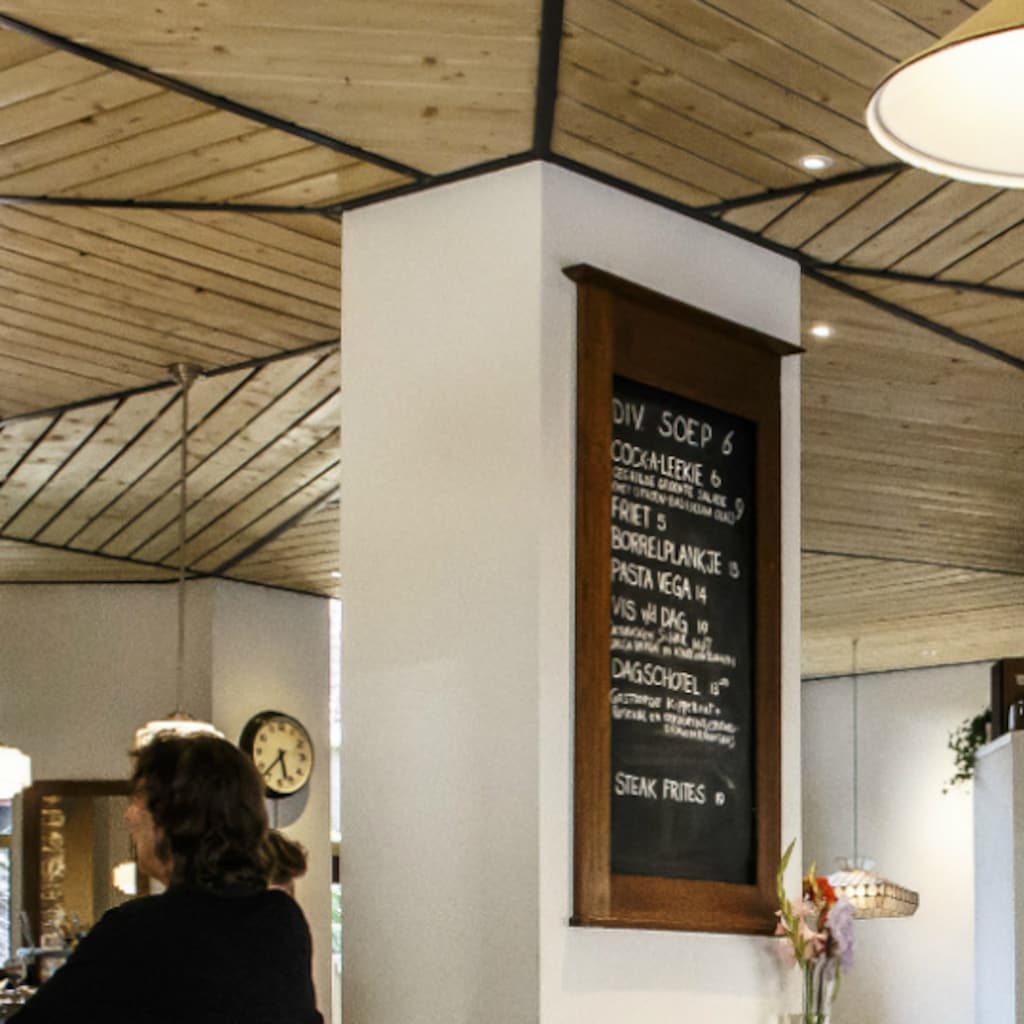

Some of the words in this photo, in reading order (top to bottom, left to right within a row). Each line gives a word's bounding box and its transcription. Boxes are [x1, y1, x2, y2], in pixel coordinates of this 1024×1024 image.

[658, 411, 712, 448] SOEP
[721, 430, 735, 456] 6
[710, 469, 722, 489] 6
[611, 496, 651, 529] FRIET
[656, 513, 667, 531] 5
[611, 526, 722, 575] BORRELPLANKJE
[611, 558, 653, 590] PASTA
[657, 571, 692, 600] VEGA
[612, 596, 636, 621] VIS
[661, 606, 688, 634] DAG
[612, 657, 701, 695] DAGSCHOTEL
[615, 771, 657, 799] STEAK
[662, 778, 706, 805] FRITES
